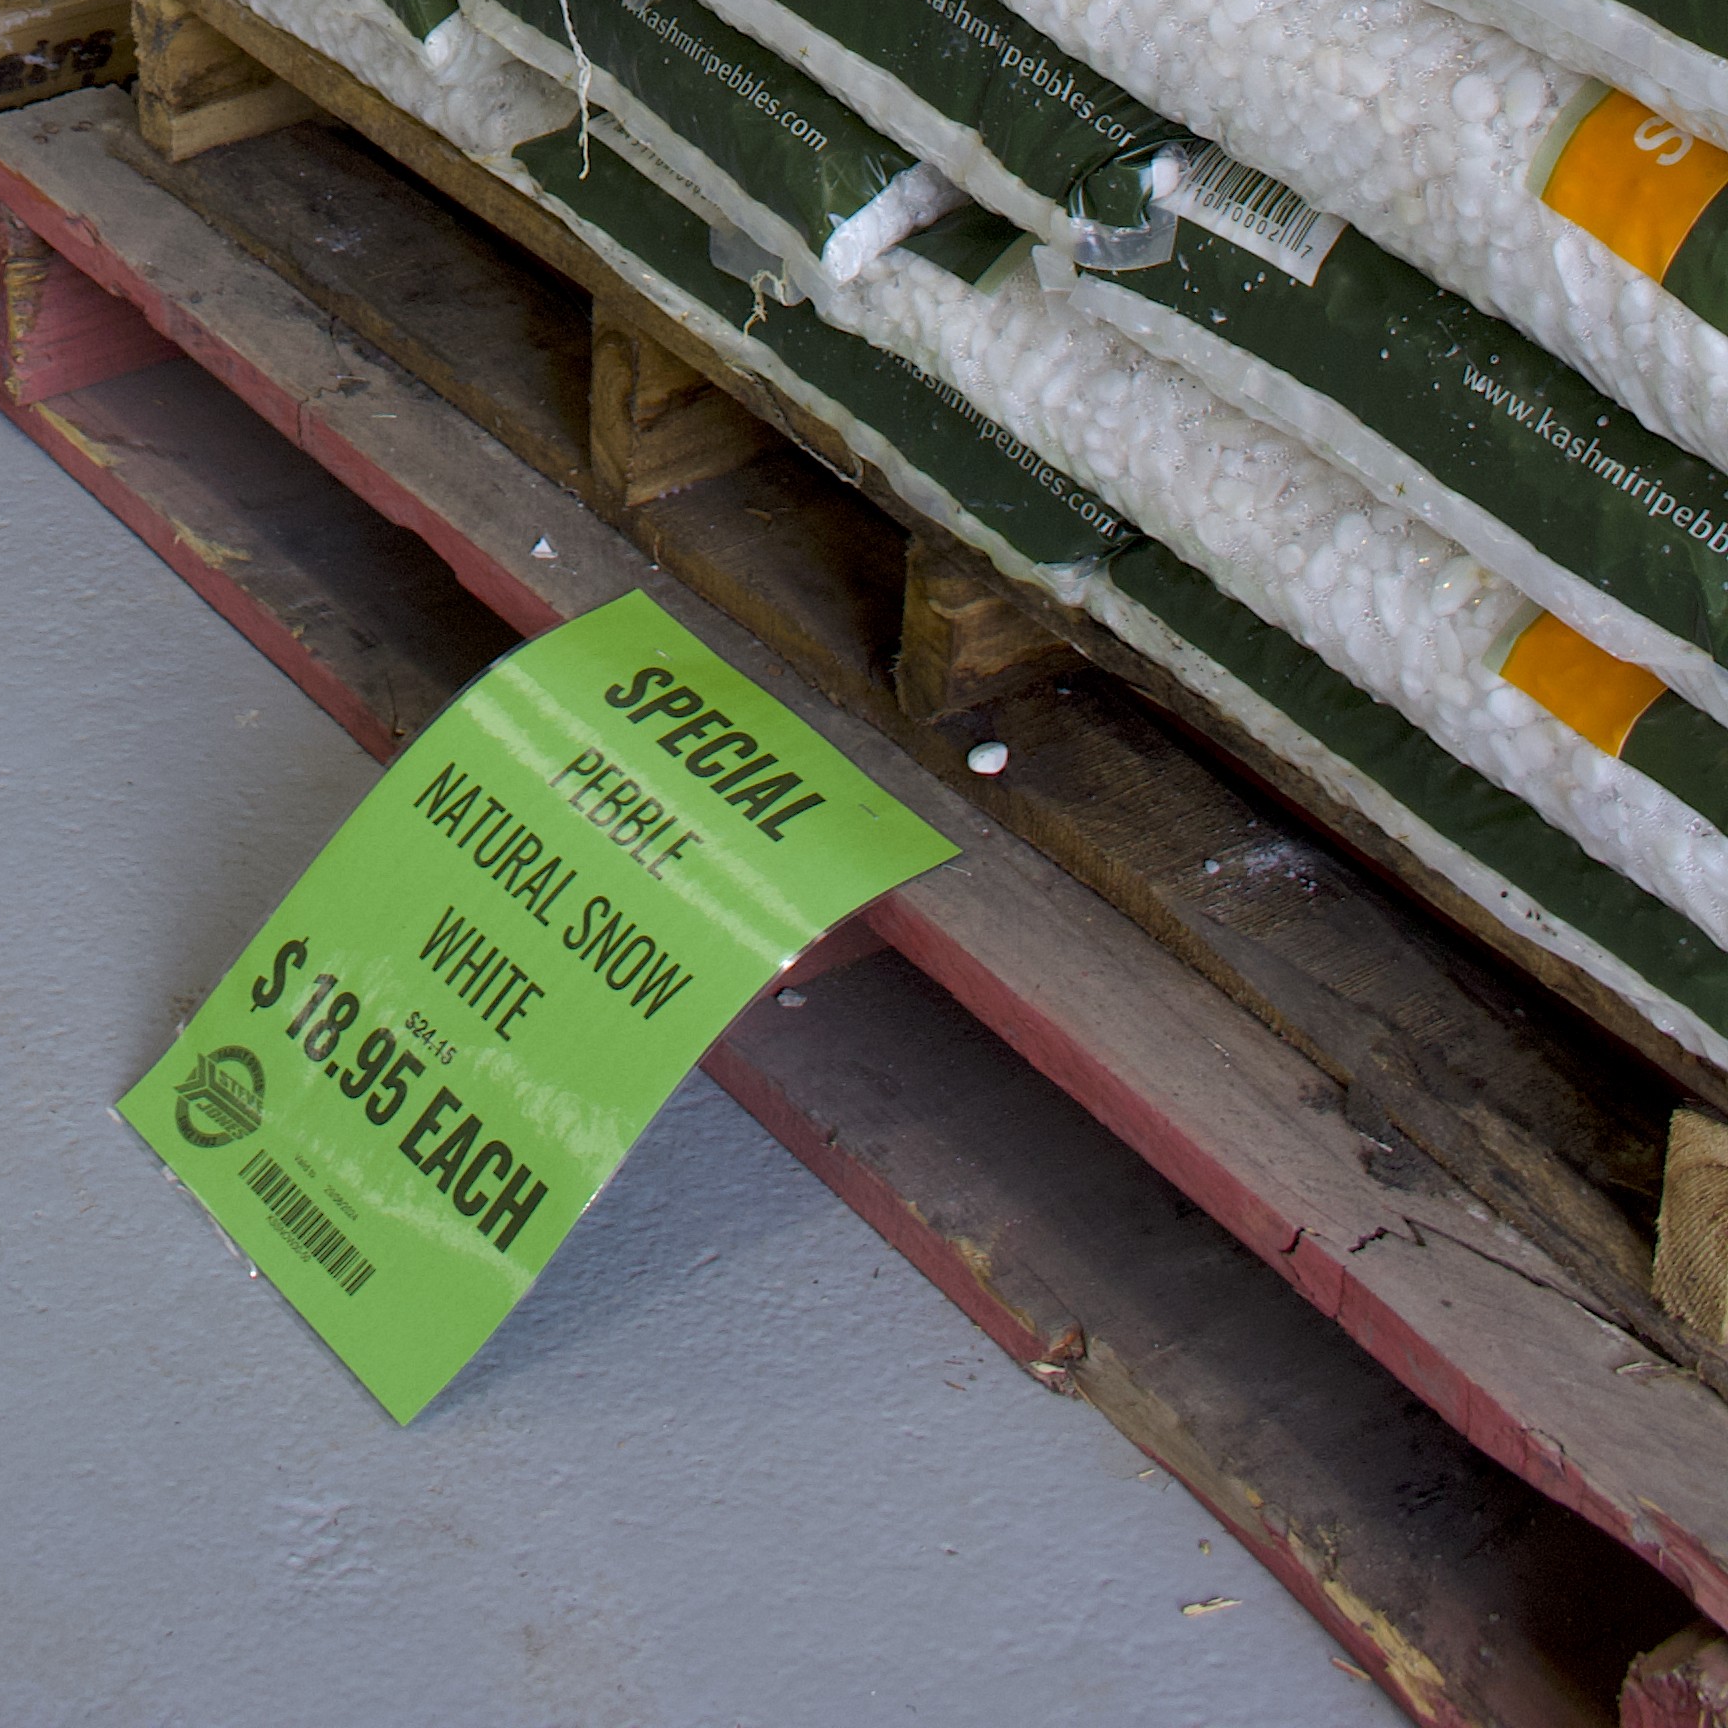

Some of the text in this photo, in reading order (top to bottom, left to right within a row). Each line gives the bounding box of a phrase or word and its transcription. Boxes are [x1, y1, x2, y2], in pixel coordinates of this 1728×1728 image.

[548, 747, 705, 881] PEBBLE
[604, 666, 827, 843] SPECIAL
[412, 760, 693, 1021] NATURAL SNOW
[404, 1009, 458, 1066] $24.15
[418, 904, 546, 1044] WHITE
[195, 1101, 245, 1141] JONES
[398, 1095, 548, 1255] EACH
